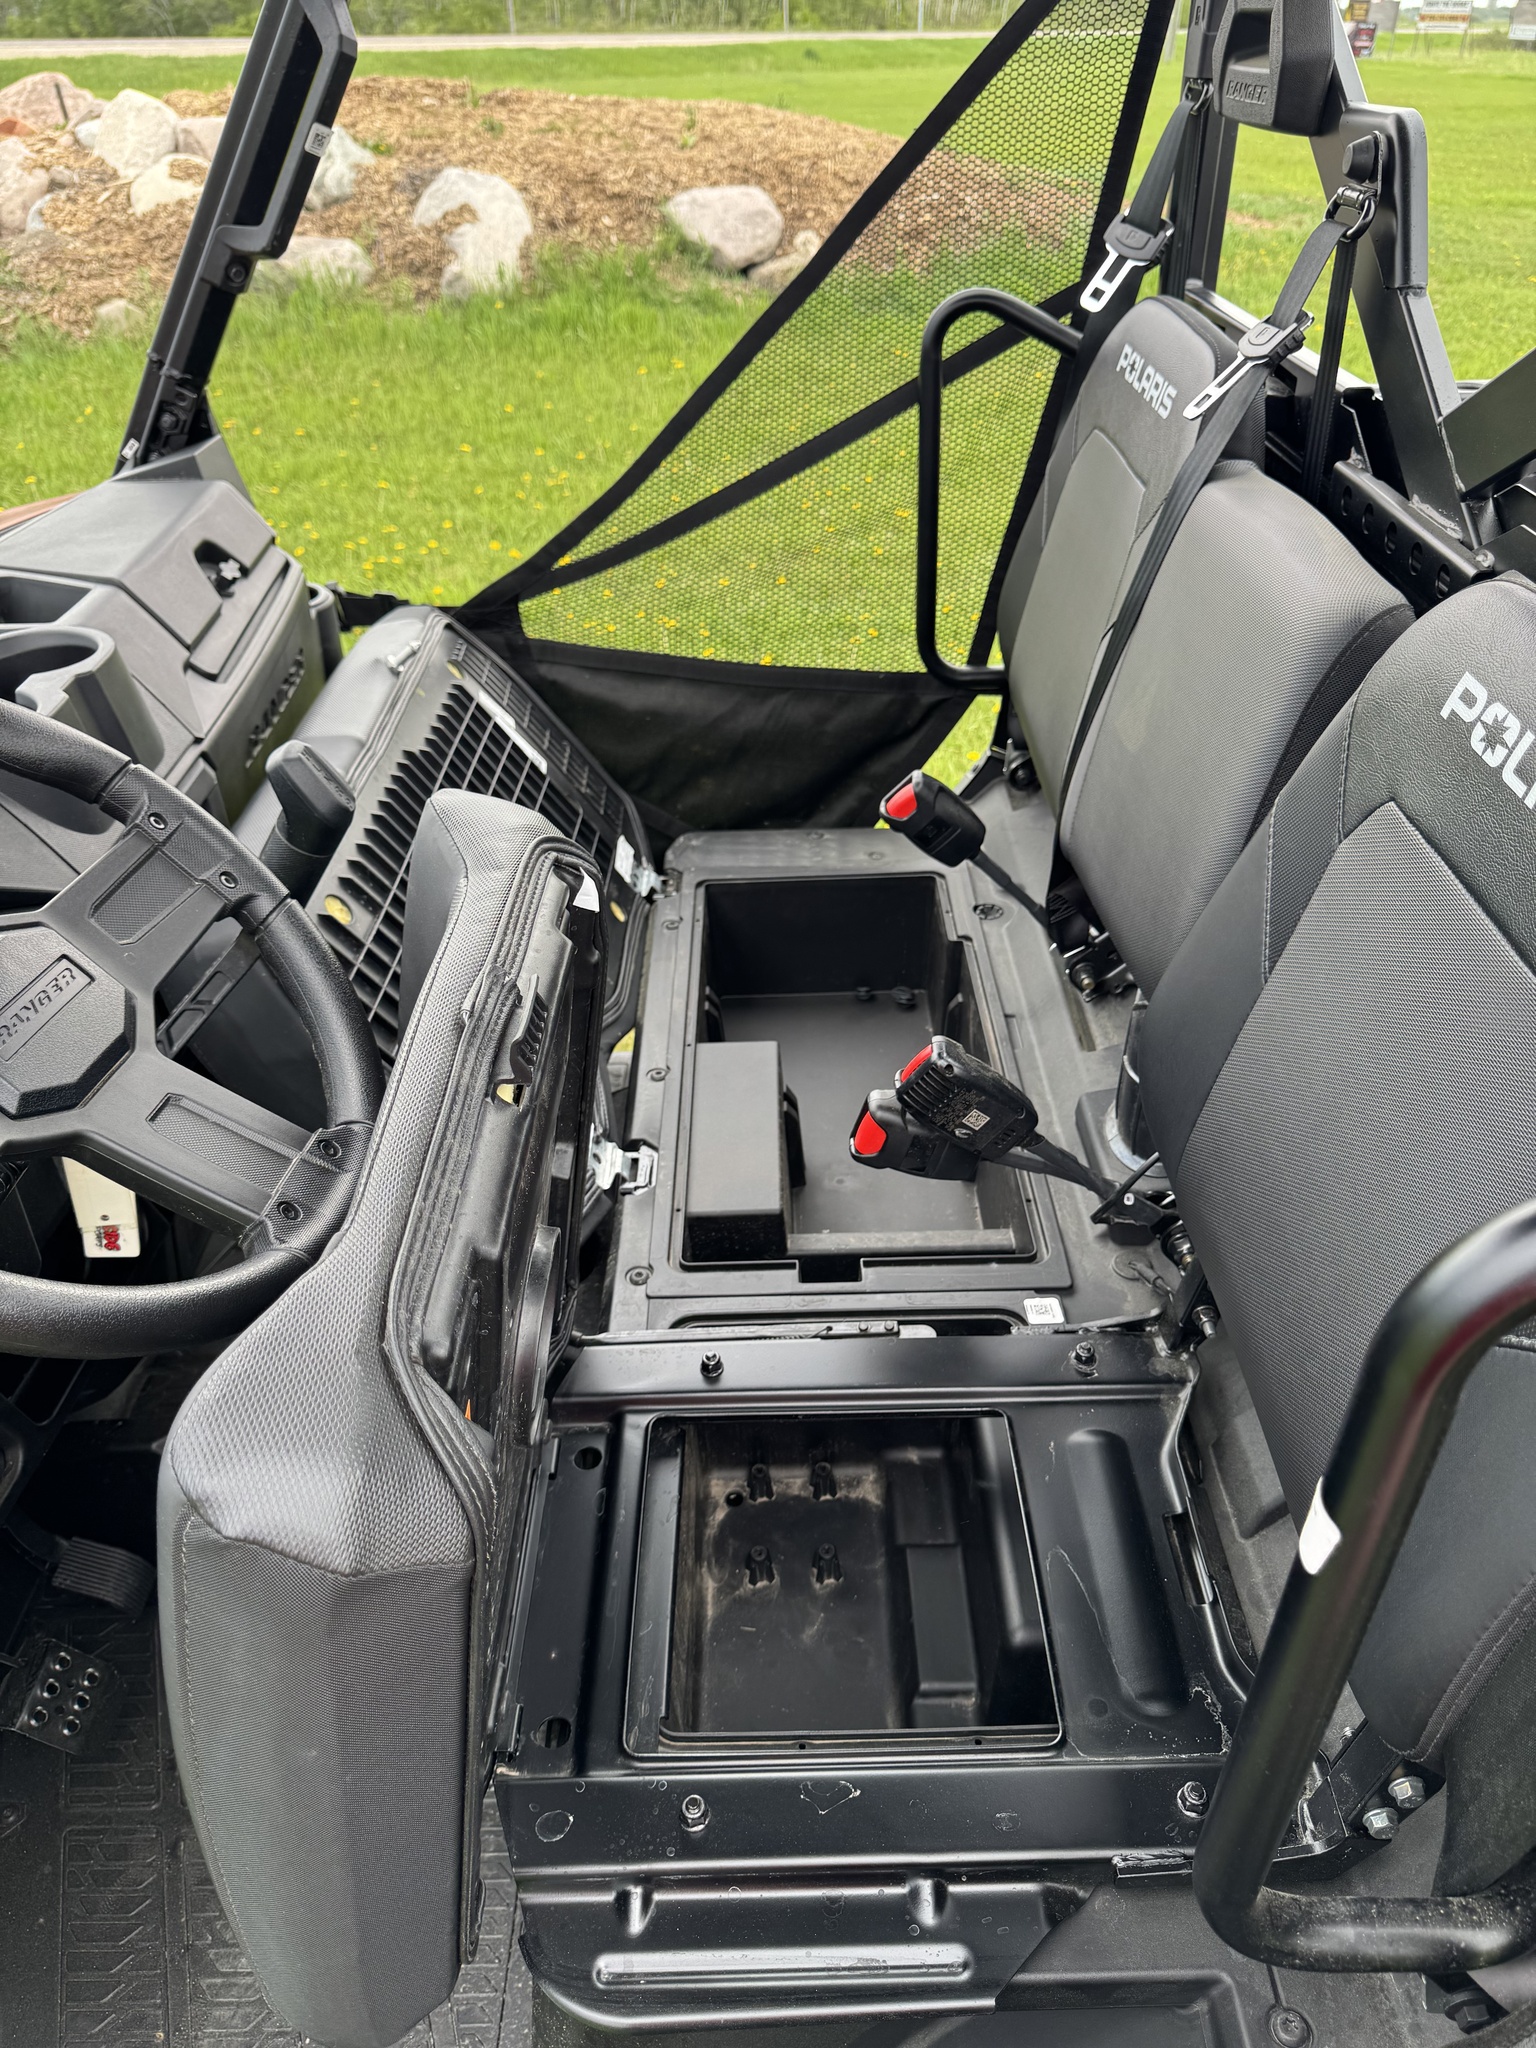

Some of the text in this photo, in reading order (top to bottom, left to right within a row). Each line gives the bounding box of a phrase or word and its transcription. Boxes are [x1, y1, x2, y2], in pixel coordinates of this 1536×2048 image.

[1226, 80, 1269, 105] RANGER
[1115, 343, 1178, 420] POLARIS
[1439, 671, 1536, 810] POL
[0, 967, 77, 1047] RANGER
